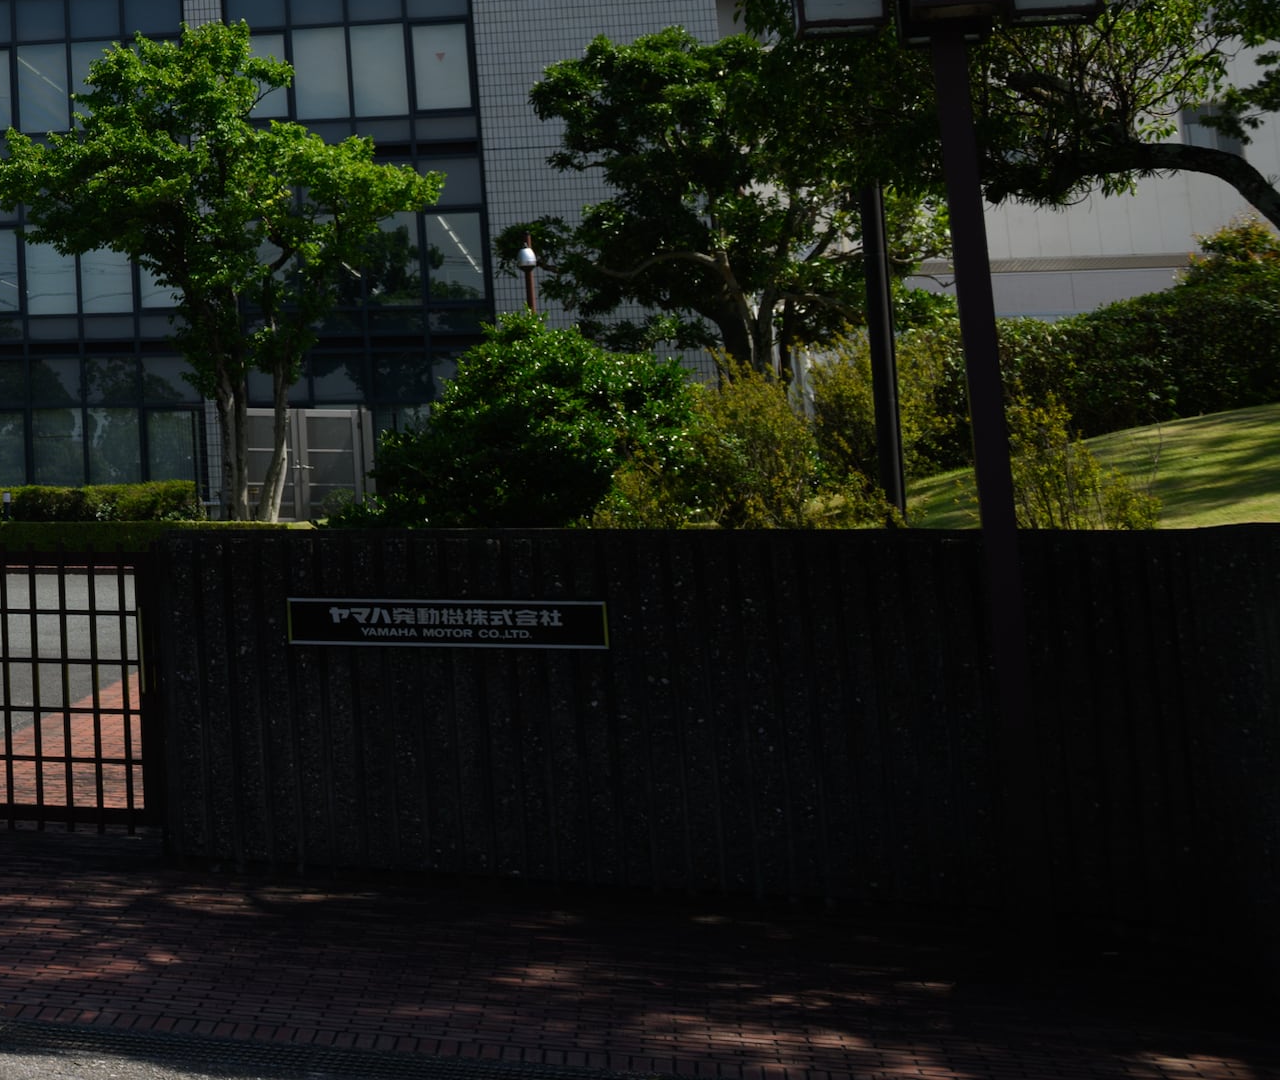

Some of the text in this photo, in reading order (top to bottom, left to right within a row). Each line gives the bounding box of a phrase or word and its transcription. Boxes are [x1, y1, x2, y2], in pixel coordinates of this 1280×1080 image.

[329, 607, 563, 626] ヤマハ発動機株式会社
[361, 627, 418, 637] YAMAHA
[422, 628, 473, 638] MOTOR
